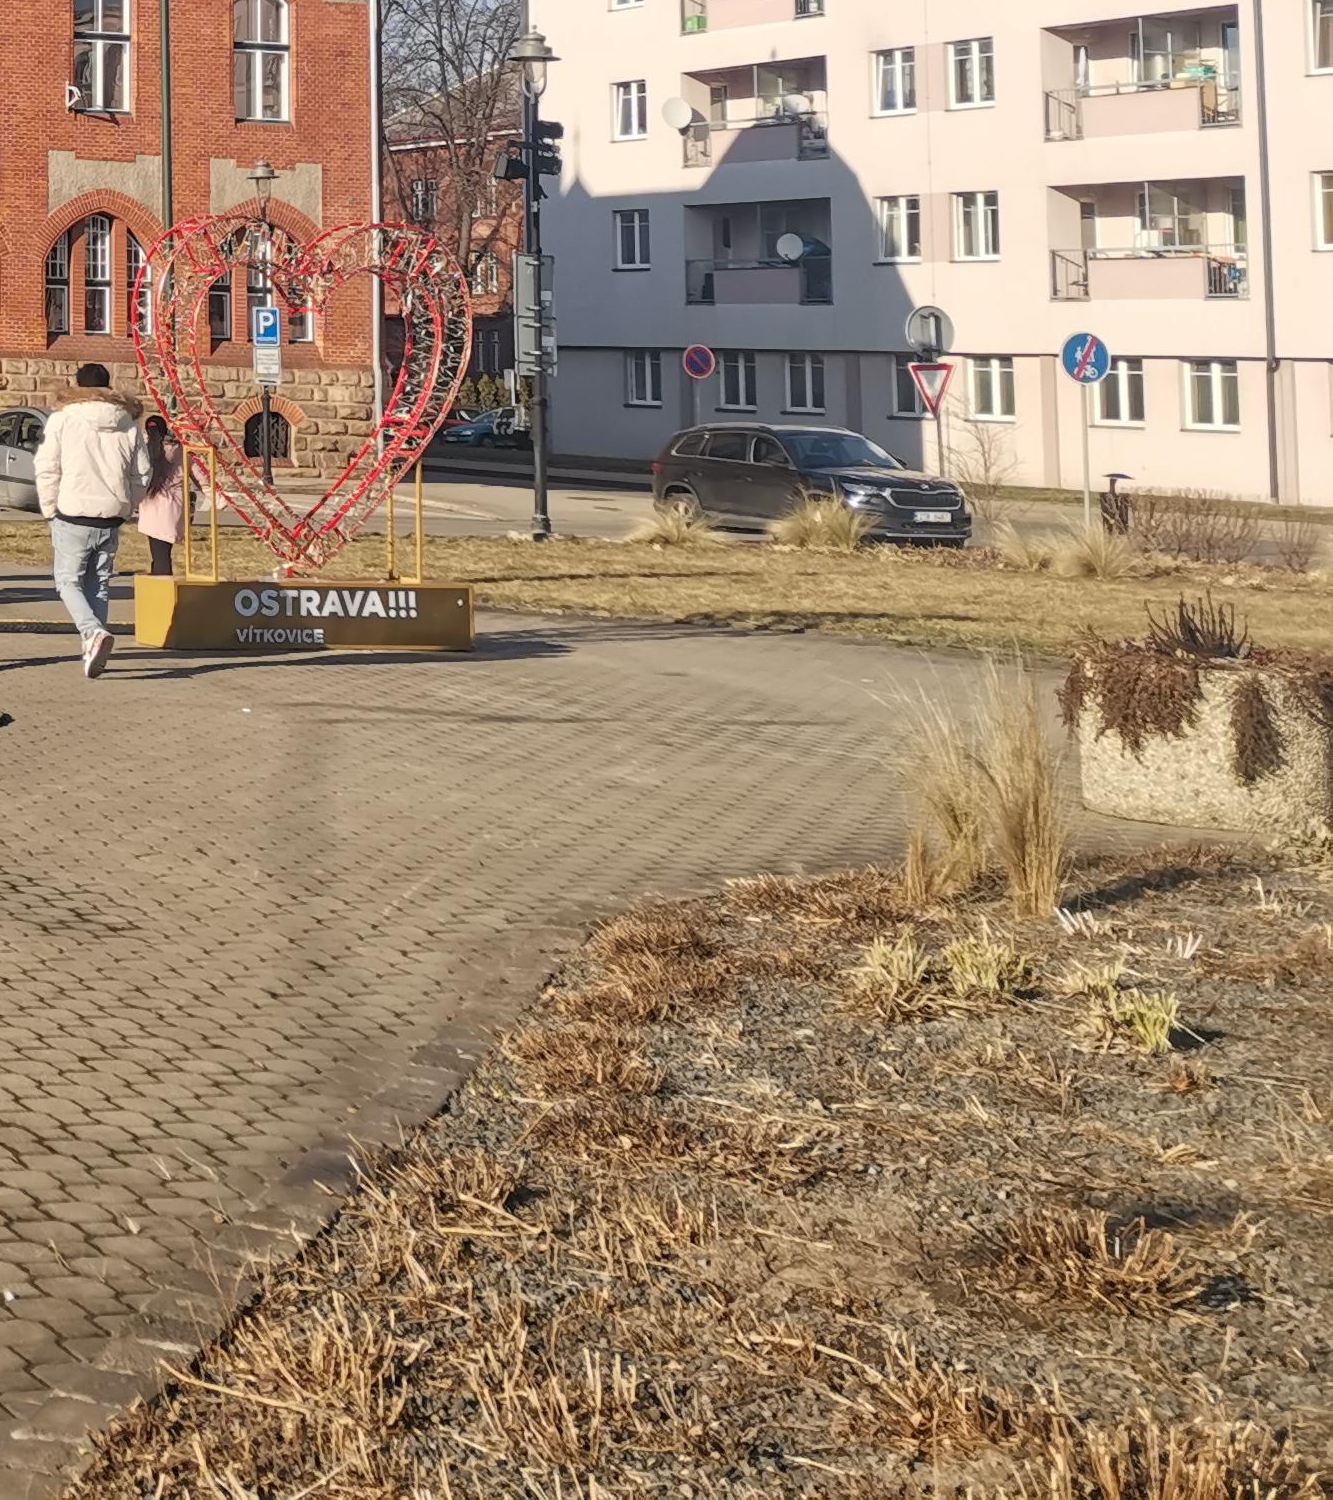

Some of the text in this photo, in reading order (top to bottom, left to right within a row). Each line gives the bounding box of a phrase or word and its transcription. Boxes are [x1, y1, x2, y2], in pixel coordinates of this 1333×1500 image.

[259, 312, 274, 335] P
[234, 588, 419, 619] OSTRAVA!!!
[236, 625, 325, 644] VÍTKOVICE
